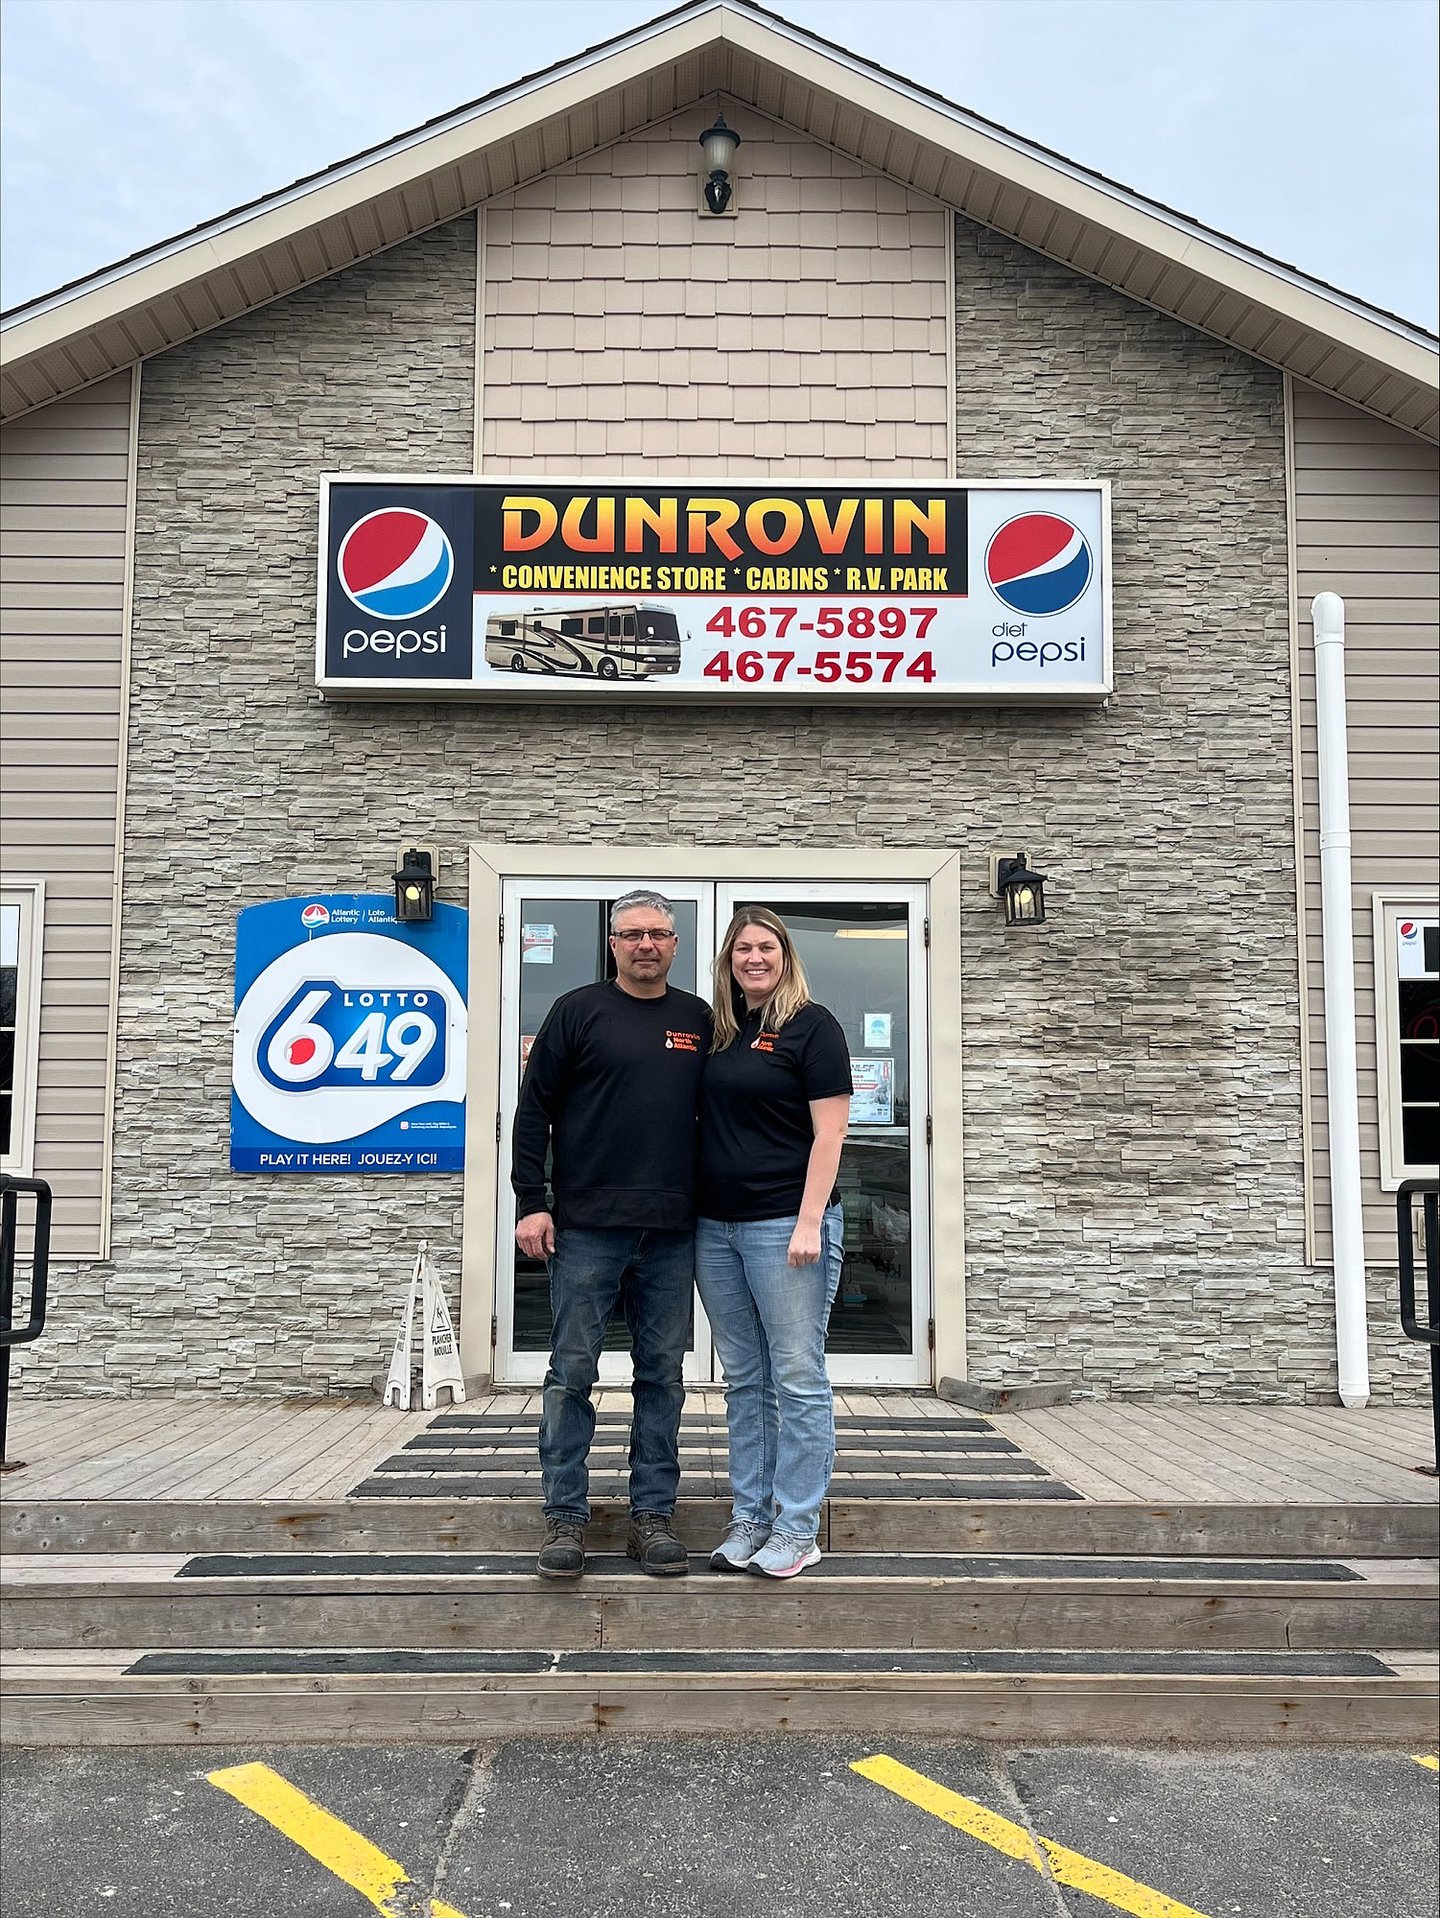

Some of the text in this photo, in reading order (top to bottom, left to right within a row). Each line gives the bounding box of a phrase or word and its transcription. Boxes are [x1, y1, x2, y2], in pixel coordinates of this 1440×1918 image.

[501, 496, 946, 561] DUNROVIN
[502, 564, 948, 591] CONVENIENCE STORE CABINS R.V. PARK
[706, 606, 938, 639] 467-5897
[992, 622, 1028, 637] diet
[343, 624, 447, 659] pepsi
[991, 636, 1086, 667] pepsi
[703, 650, 936, 683] 467-5574
[331, 916, 358, 924] Lottery
[344, 993, 429, 1007] LOTTO
[260, 1154, 437, 1165] PLAY IT HERE! JOUEZ-Y ICI!
